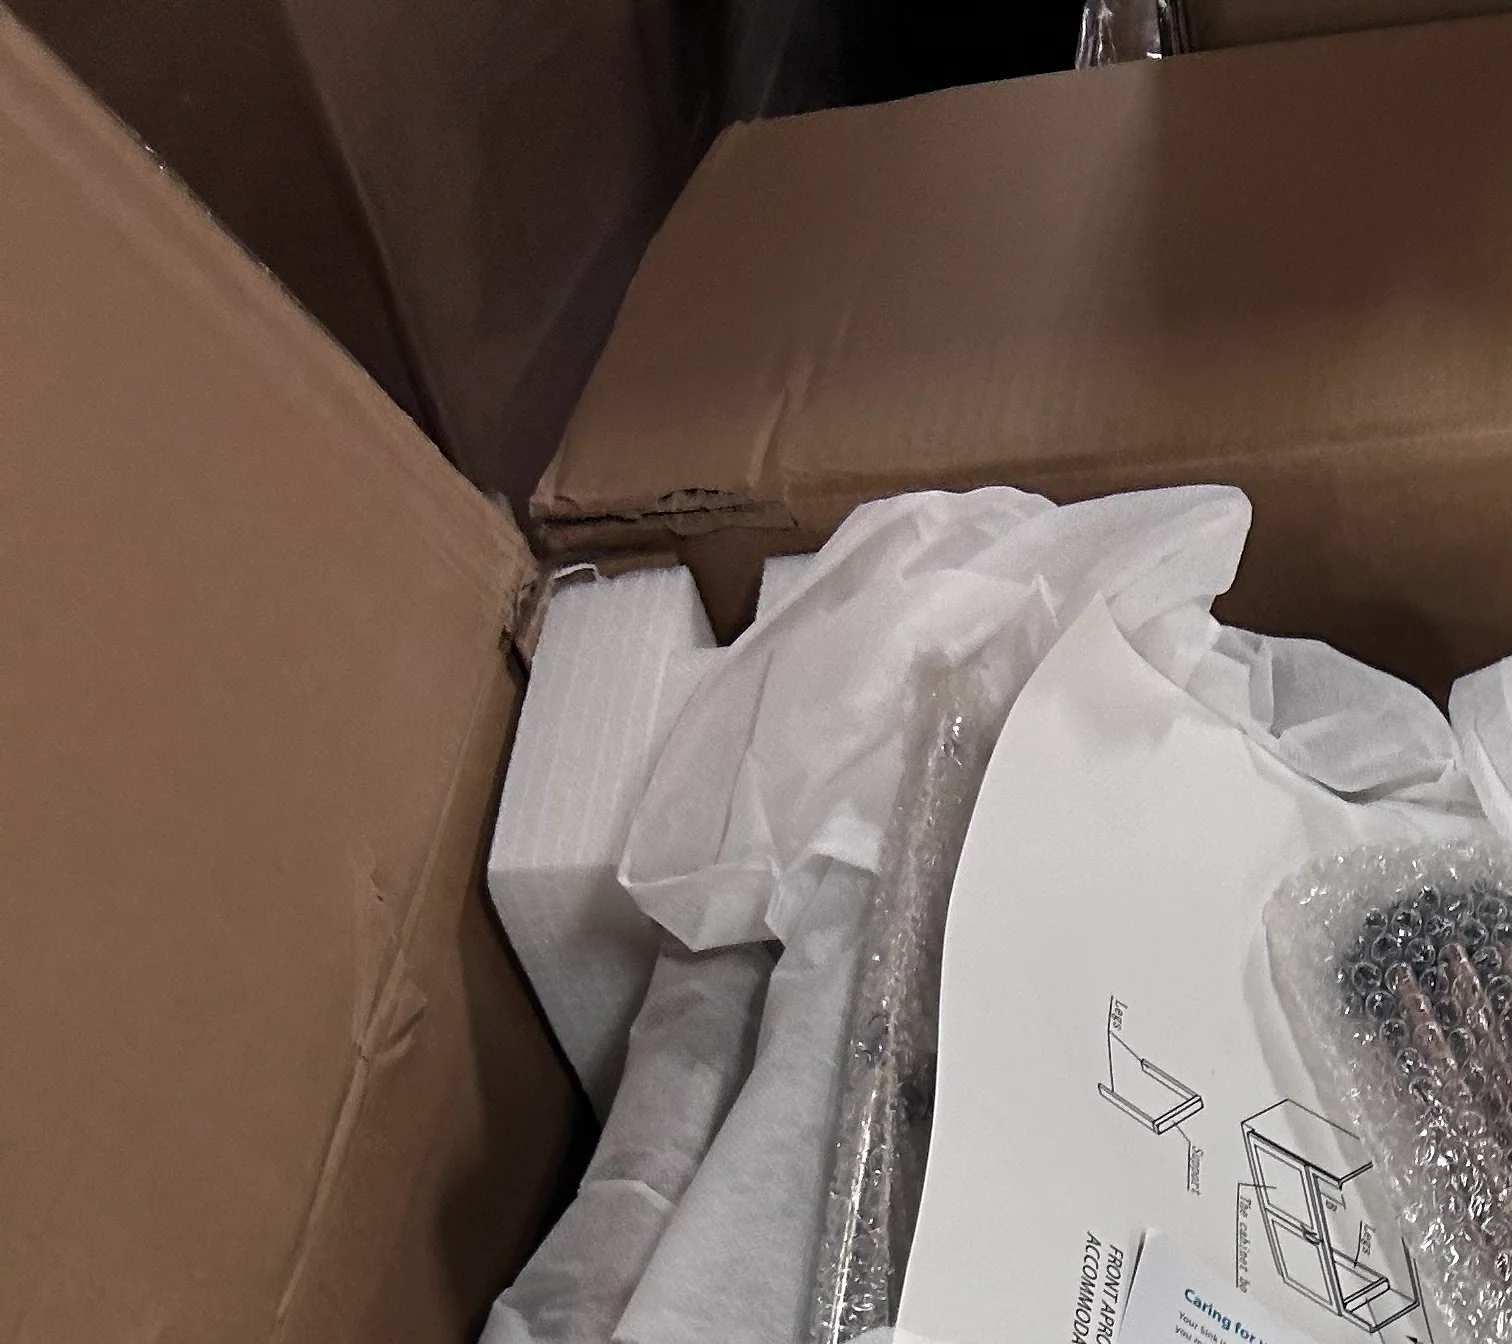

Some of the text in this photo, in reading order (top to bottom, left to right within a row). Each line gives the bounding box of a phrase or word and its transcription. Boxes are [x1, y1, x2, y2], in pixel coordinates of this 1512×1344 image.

[1111, 1000, 1128, 1030] Legs
[1103, 1244, 1123, 1304] FRONT
[1238, 1222, 1253, 1273] cabinet
[1180, 1287, 1234, 1332] Caring
[1232, 1320, 1256, 1343] for
